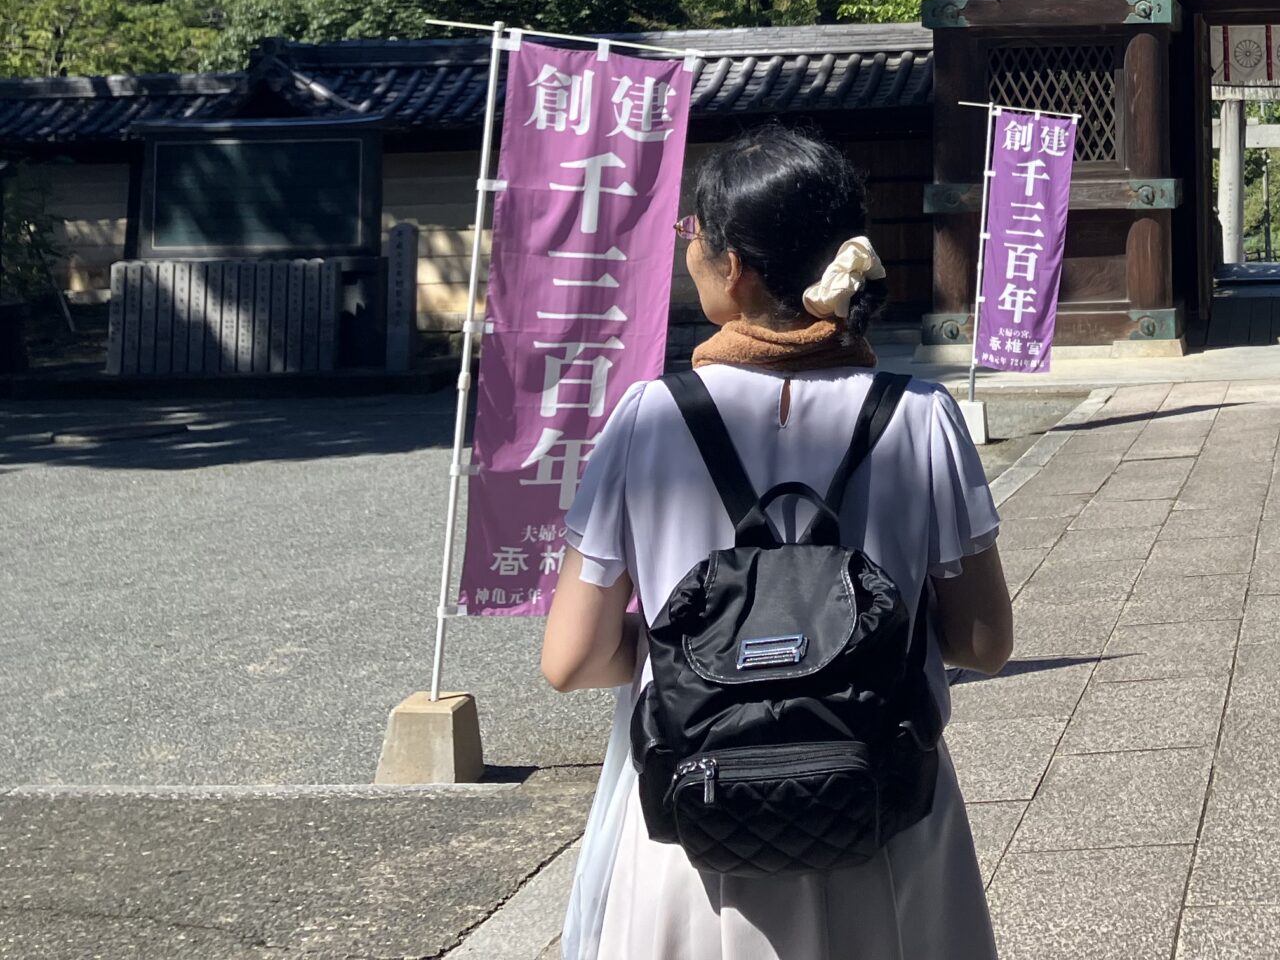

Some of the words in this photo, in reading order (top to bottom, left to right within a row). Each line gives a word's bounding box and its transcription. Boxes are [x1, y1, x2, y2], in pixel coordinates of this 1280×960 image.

[523, 63, 676, 141] 創建
[1002, 120, 1069, 157] 創建
[998, 158, 1050, 324] 千三百年
[518, 151, 637, 510] 千三百年
